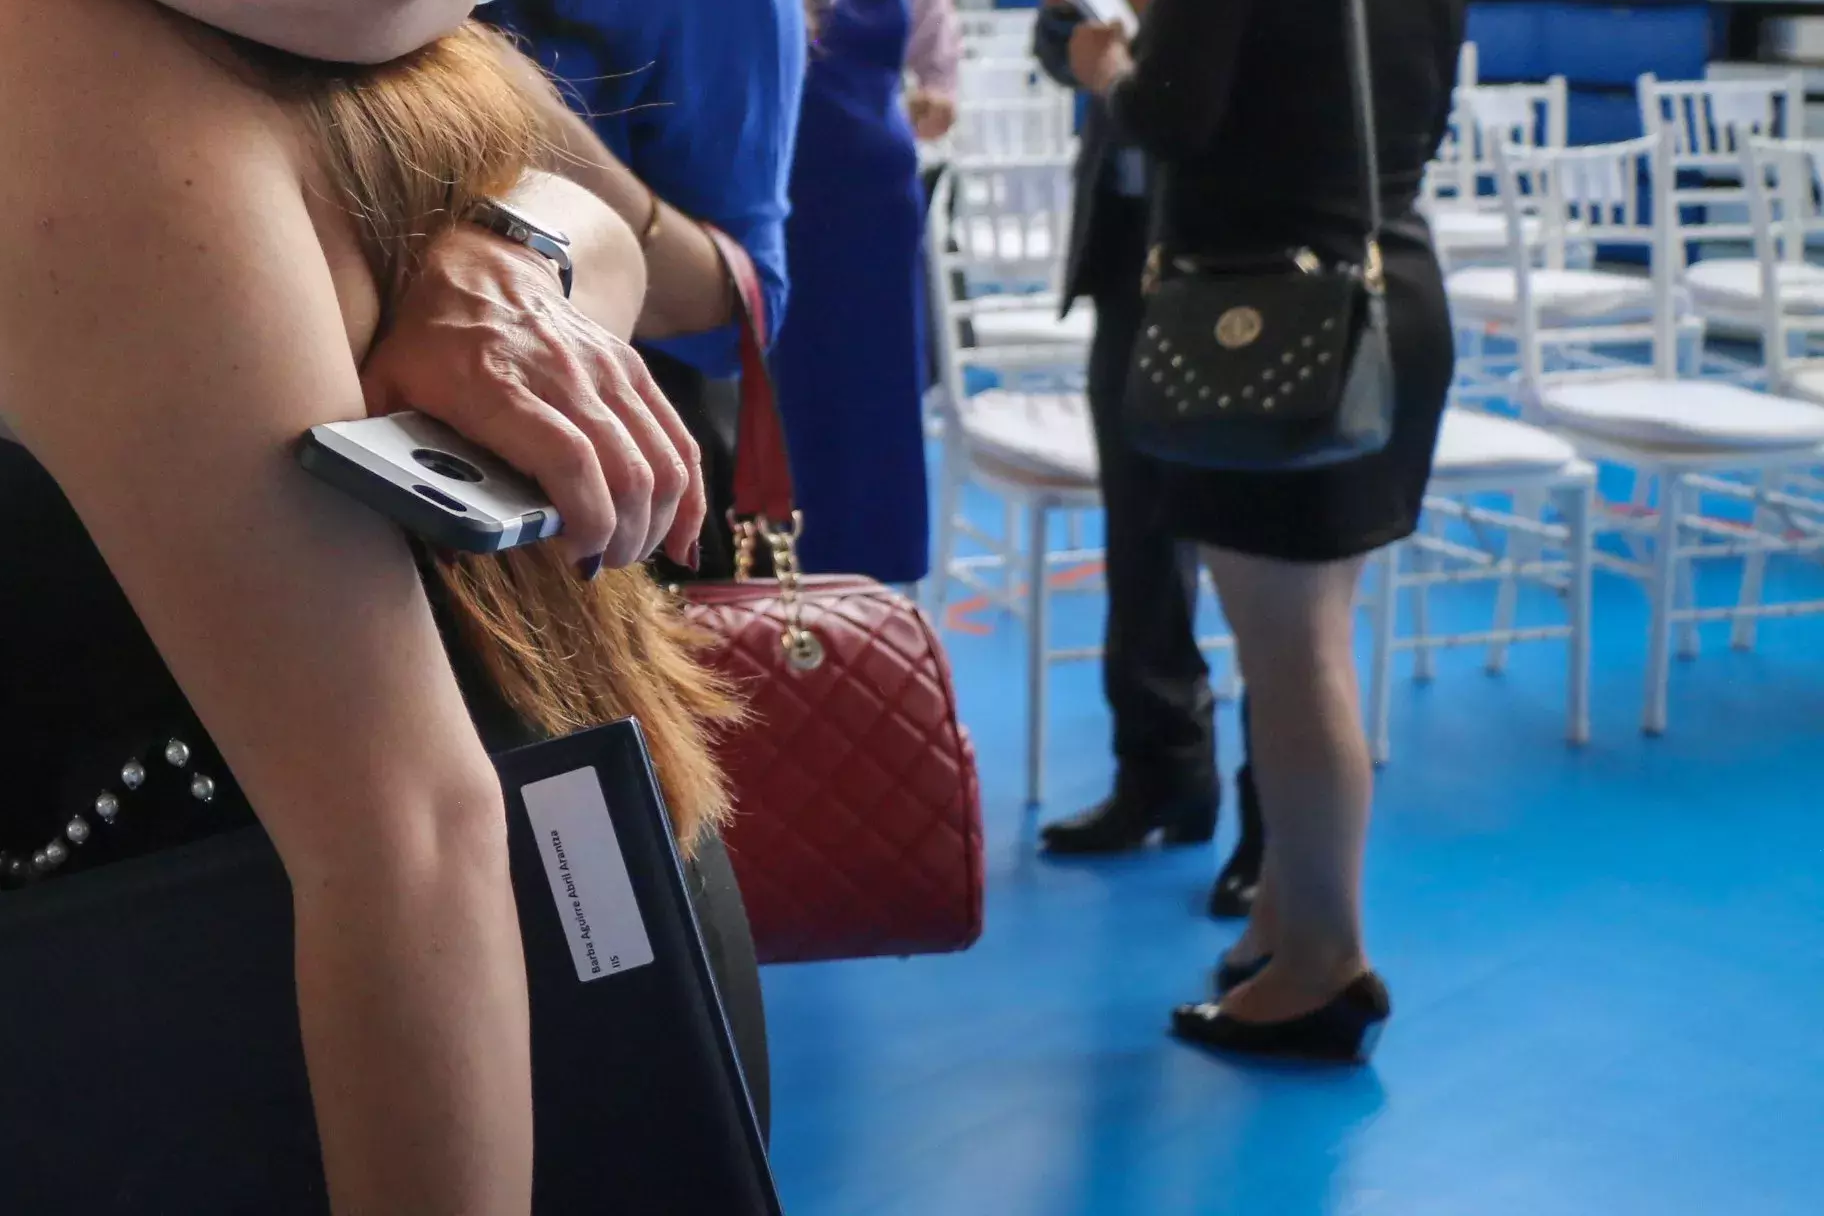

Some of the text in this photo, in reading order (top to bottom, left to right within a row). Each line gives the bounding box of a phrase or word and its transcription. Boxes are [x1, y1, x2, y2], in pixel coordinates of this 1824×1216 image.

[550, 830, 601, 974] Barba Aguirre Abril Arantza
